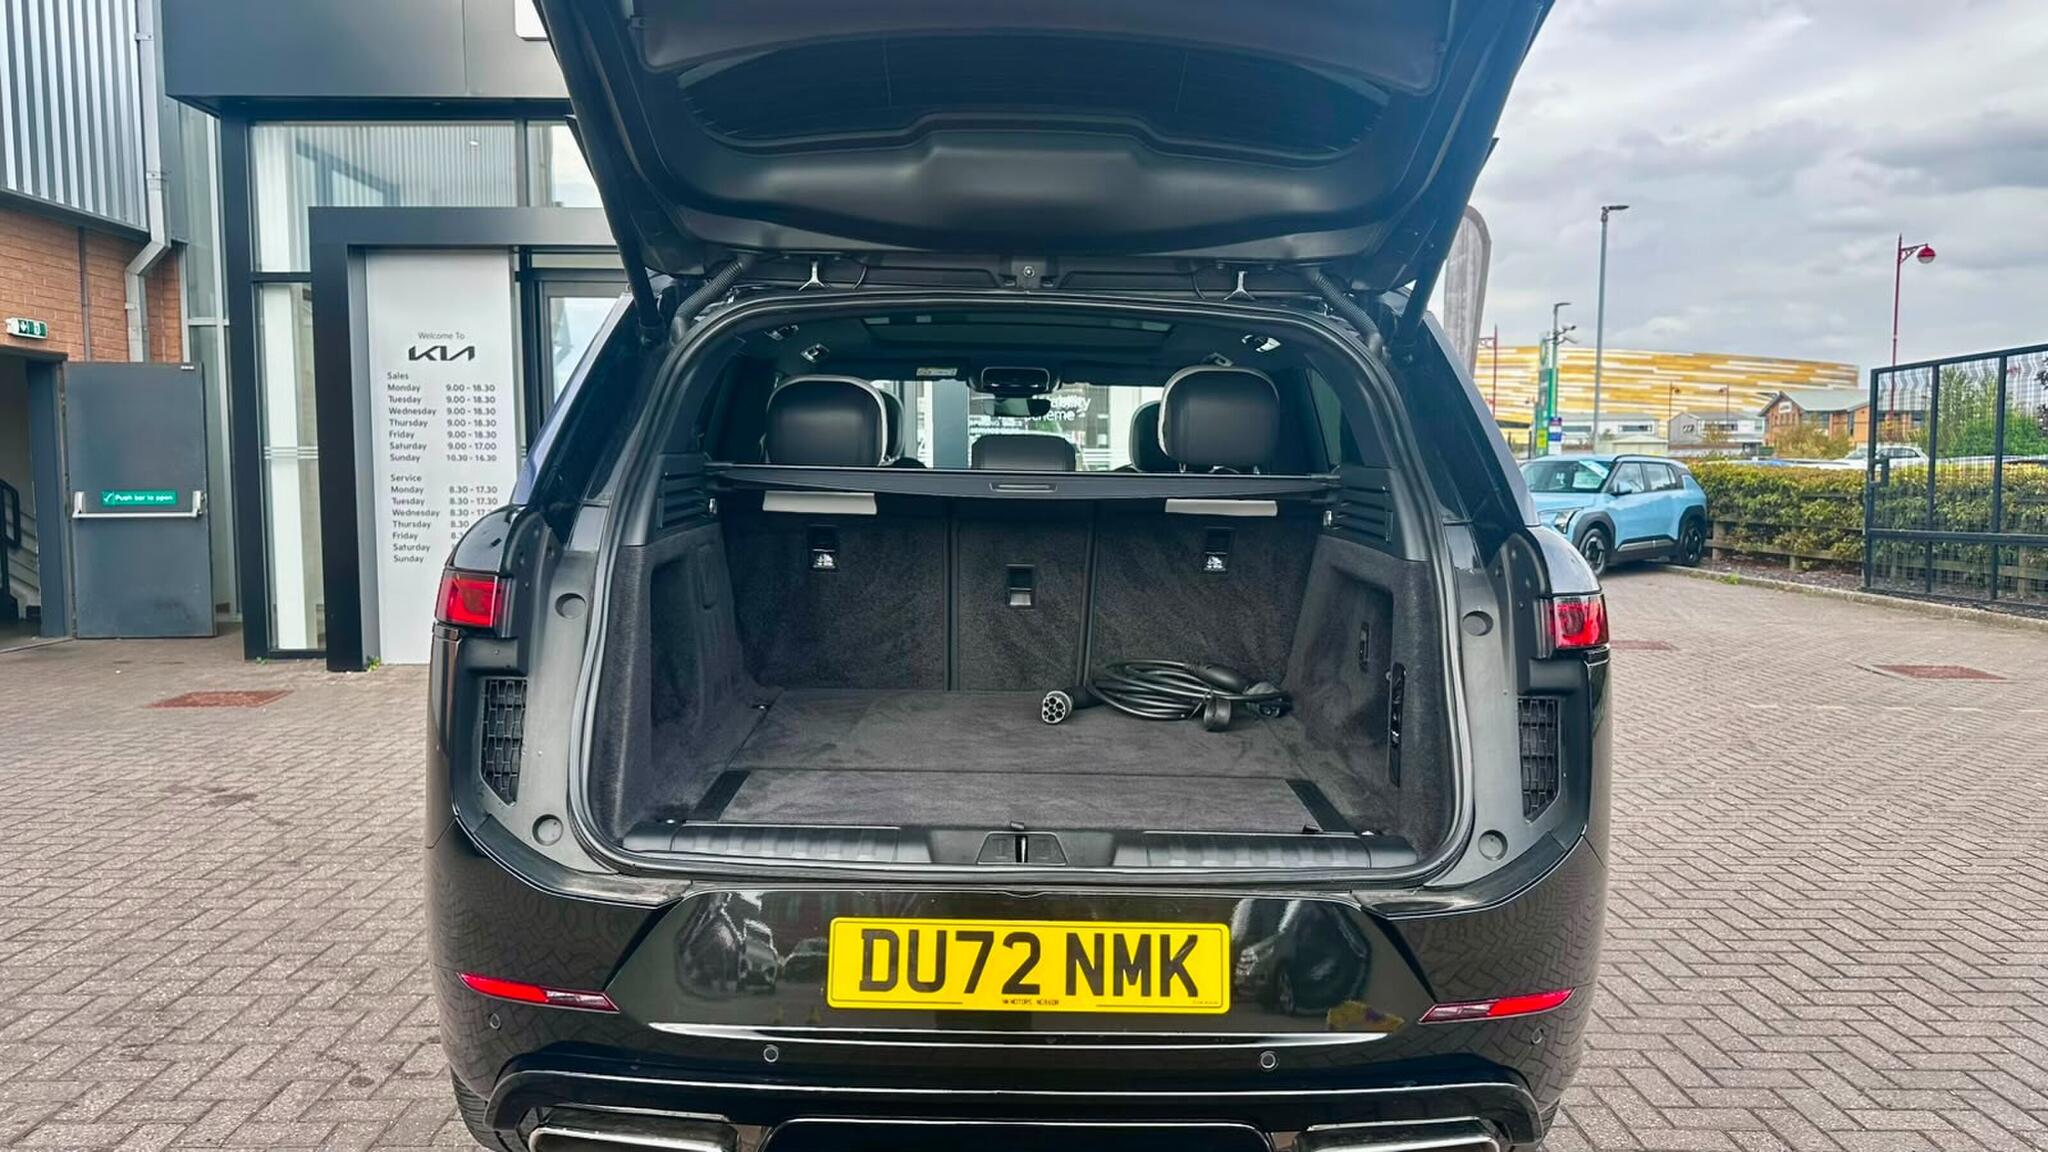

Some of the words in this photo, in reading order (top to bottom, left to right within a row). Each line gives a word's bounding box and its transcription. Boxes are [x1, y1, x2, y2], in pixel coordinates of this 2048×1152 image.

[409, 346, 475, 361] KIA
[387, 372, 408, 380] Sales
[388, 384, 421, 392] Monday
[389, 396, 421, 404] Tuesday
[389, 408, 437, 416] Wednesday
[389, 419, 428, 427] Thursday
[389, 431, 415, 439] Friday
[390, 442, 427, 451] Saturday
[391, 454, 420, 463] Sunday
[391, 474, 422, 482] Service
[391, 486, 424, 494] Monday
[392, 498, 425, 506] Tuesday
[393, 509, 440, 517] Wednesday
[393, 521, 431, 529] Thursday
[394, 544, 430, 552] Saturday
[860, 929, 1041, 996] DU72
[1065, 932, 1199, 998] NMK
